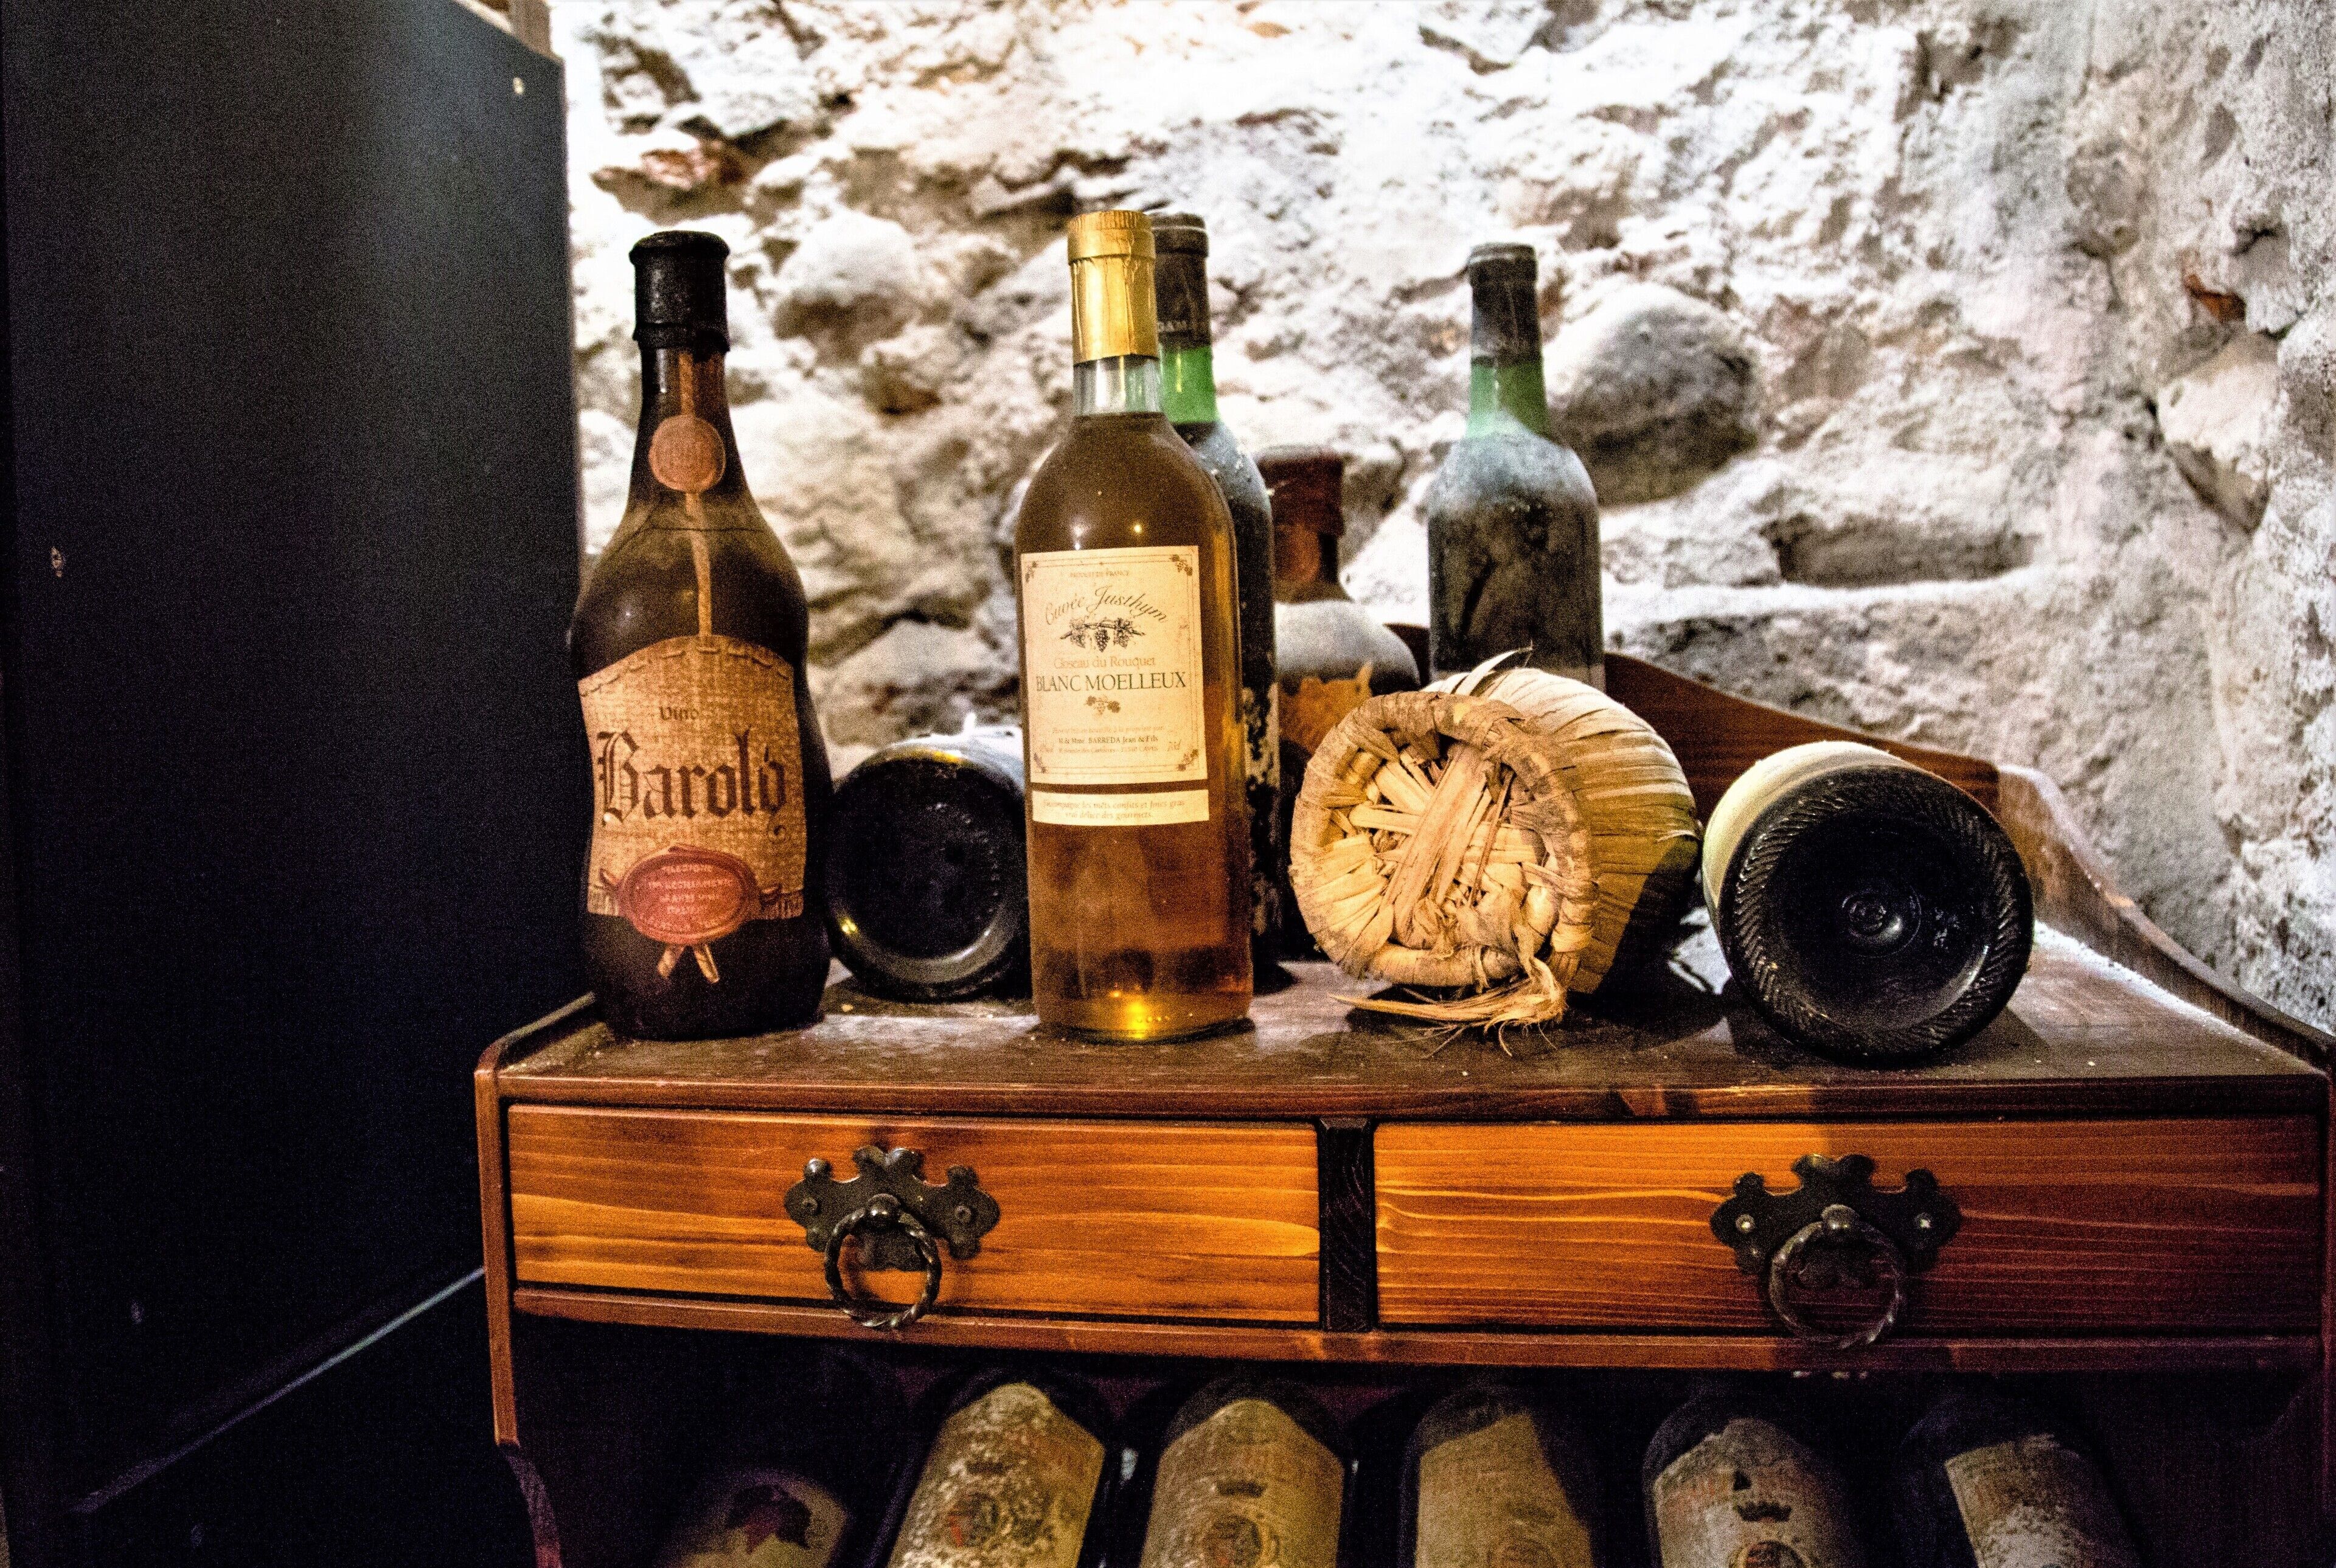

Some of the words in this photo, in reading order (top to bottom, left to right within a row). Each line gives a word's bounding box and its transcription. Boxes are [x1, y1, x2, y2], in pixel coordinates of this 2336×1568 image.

[1092, 656, 1107, 668] du
[1110, 656, 1156, 670] Rouquet
[1036, 675, 1081, 692] BLANC
[1085, 671, 1186, 692] MOELLEUX
[596, 729, 787, 827] Barolo
